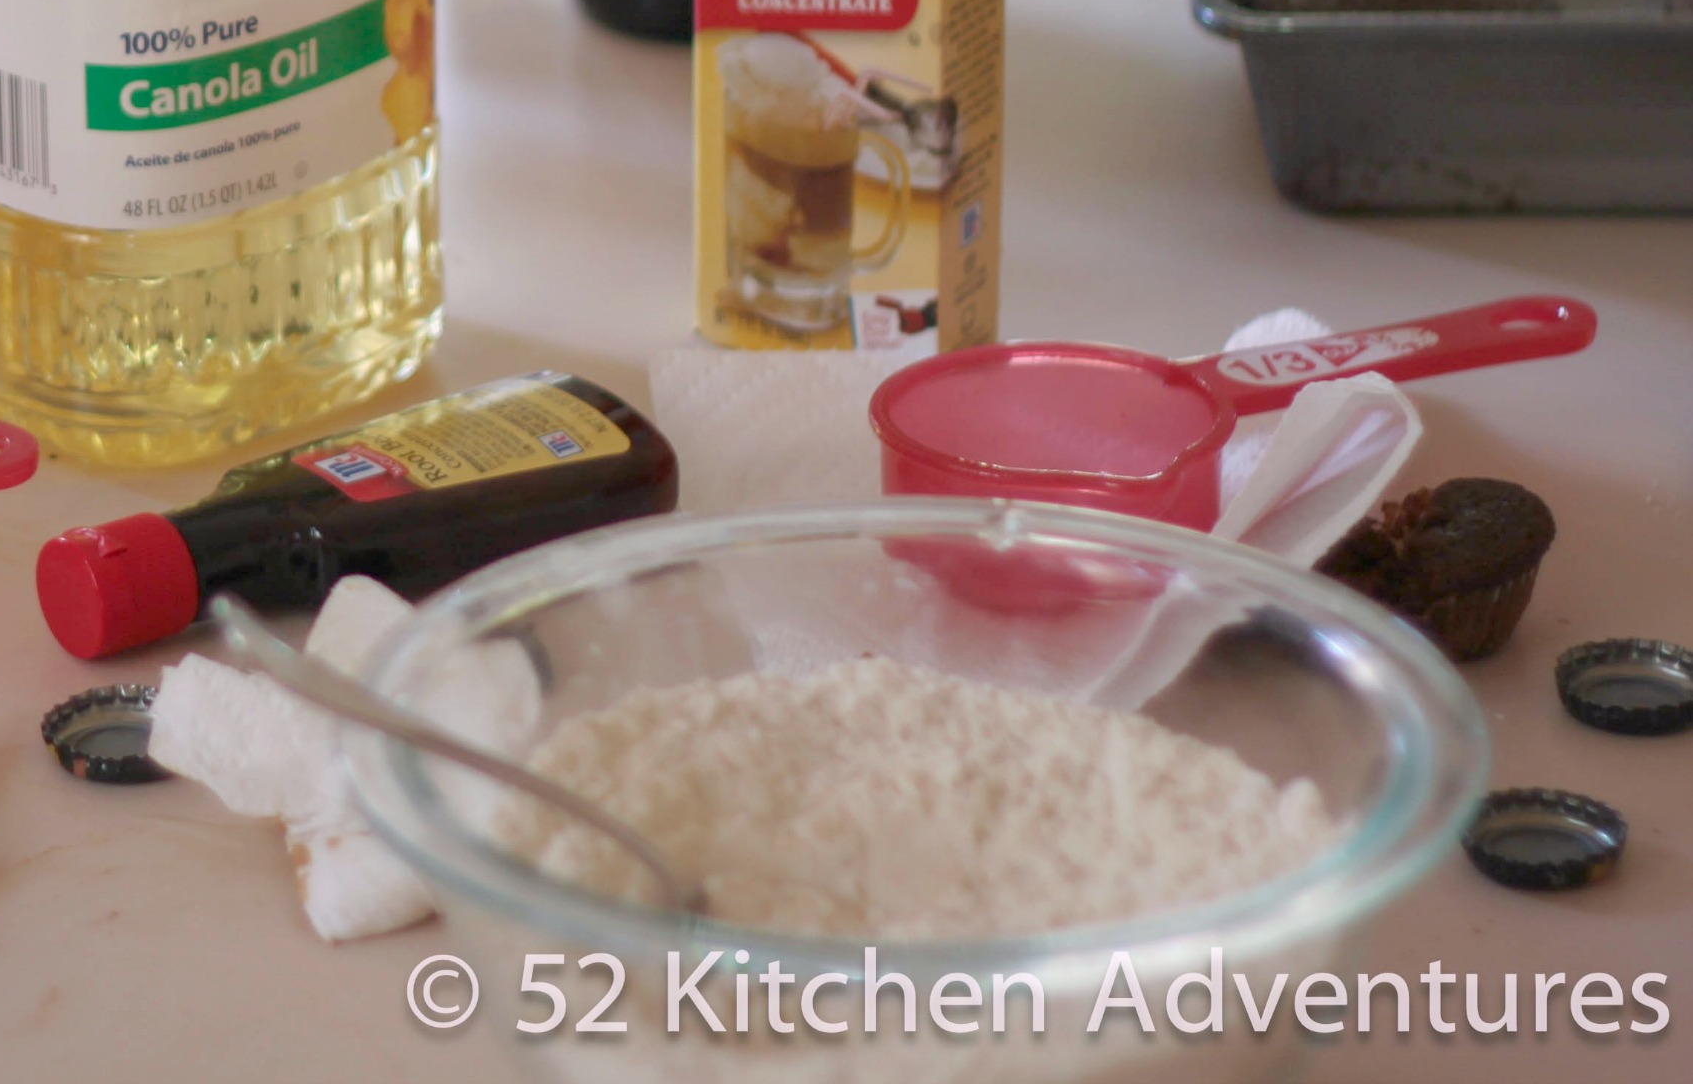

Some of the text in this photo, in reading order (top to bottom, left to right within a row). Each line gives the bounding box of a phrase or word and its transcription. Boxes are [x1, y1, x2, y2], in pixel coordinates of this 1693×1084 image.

[120, 15, 259, 55] 100% Pure
[119, 37, 319, 119] Canola Oil
[124, 121, 301, 167] Aceite de canola 100% puro
[123, 200, 143, 217] 48
[148, 198, 163, 216] FL
[168, 194, 187, 214] OZ
[191, 191, 216, 212] (1.5
[220, 182, 243, 207] QT)
[1227, 351, 1316, 379] 1/3
[399, 449, 448, 483] Root
